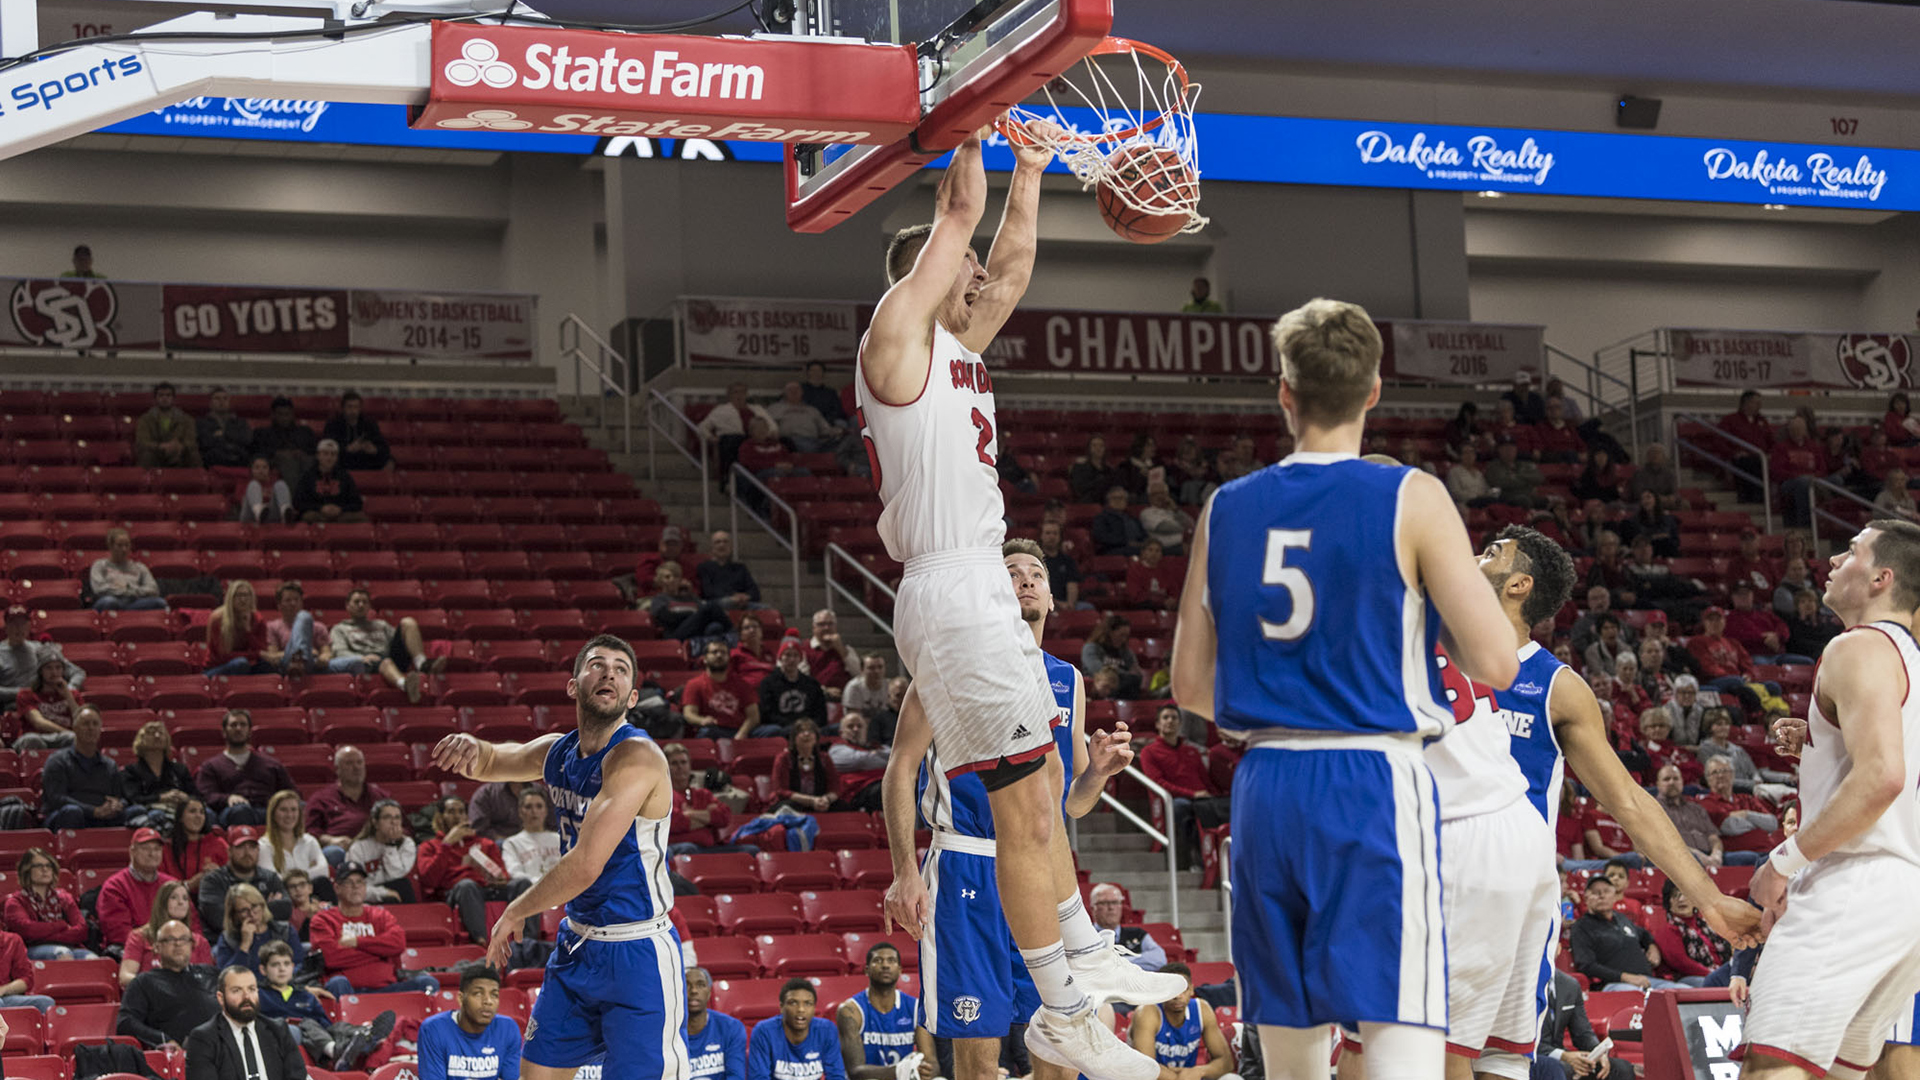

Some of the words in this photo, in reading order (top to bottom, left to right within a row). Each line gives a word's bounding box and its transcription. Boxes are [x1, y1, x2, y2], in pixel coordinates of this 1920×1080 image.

[11, 55, 143, 110] Sports
[523, 43, 645, 94] State
[649, 51, 765, 100] Farm
[539, 113, 713, 139] State
[708, 122, 871, 144] Farm
[1830, 118, 1859, 135] 107
[1356, 130, 1464, 171] Dakota
[1467, 135, 1555, 186] Realty
[1704, 148, 1803, 187] Dakota
[1806, 153, 1888, 201] Realty
[174, 303, 221, 339] GO
[228, 296, 337, 335] YOTES
[357, 299, 428, 320] WOMEN'S
[431, 300, 524, 324] BASKETBALL
[695, 308, 760, 328] WOMEN'S
[763, 310, 849, 331] BASKETBALL
[403, 325, 482, 348] 2014-15
[736, 333, 811, 356] 2015-16
[1427, 333, 1506, 350] VOLLEYBALL
[1684, 337, 1721, 355] MEN'S
[1724, 338, 1794, 357] BASKETBALL
[1450, 354, 1488, 375] 2016
[1712, 360, 1772, 380] 2016-17
[970, 407, 997, 467] 2
[1258, 529, 1315, 642] 5
